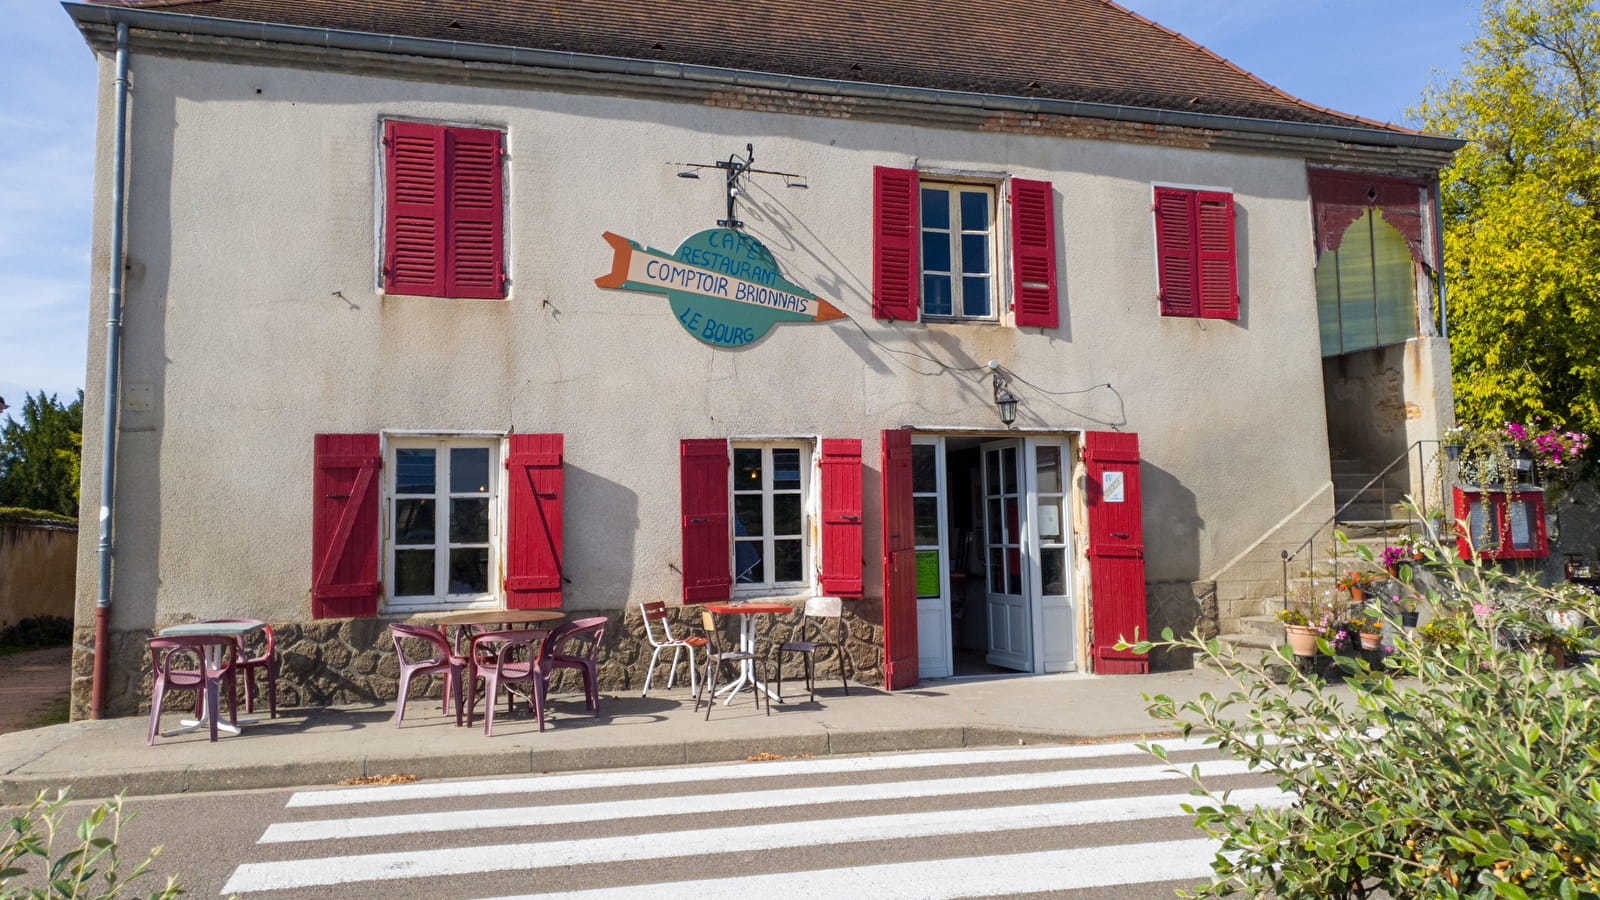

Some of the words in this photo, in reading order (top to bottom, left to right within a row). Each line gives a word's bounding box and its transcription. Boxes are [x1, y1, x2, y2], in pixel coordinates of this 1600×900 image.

[646, 260, 729, 297] COMPTOIR
[735, 282, 809, 313] BRIONNAIS
[679, 246, 780, 287] RESTAURANT
[679, 307, 703, 331] LE
[701, 319, 755, 345] BOURG
